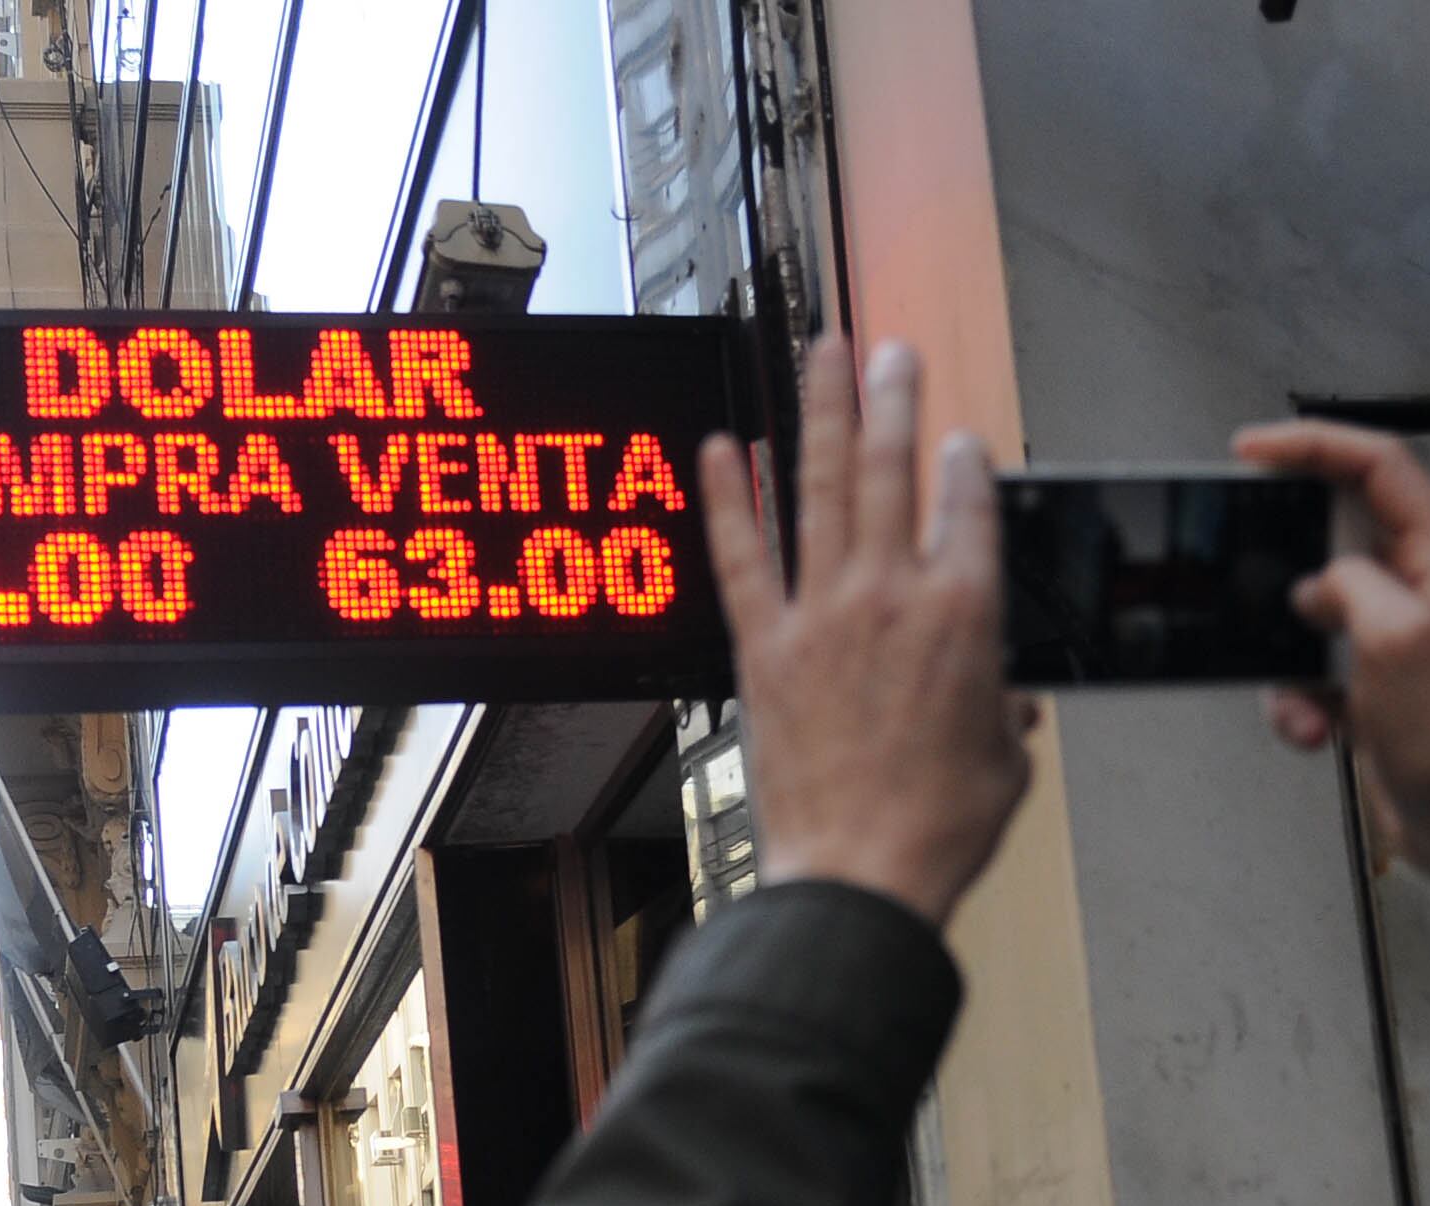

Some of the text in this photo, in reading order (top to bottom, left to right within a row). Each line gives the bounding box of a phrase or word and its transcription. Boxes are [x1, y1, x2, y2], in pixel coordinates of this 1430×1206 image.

[22, 326, 484, 421] DOLAR
[327, 431, 686, 516] VENTA
[317, 525, 677, 621] 63.00
